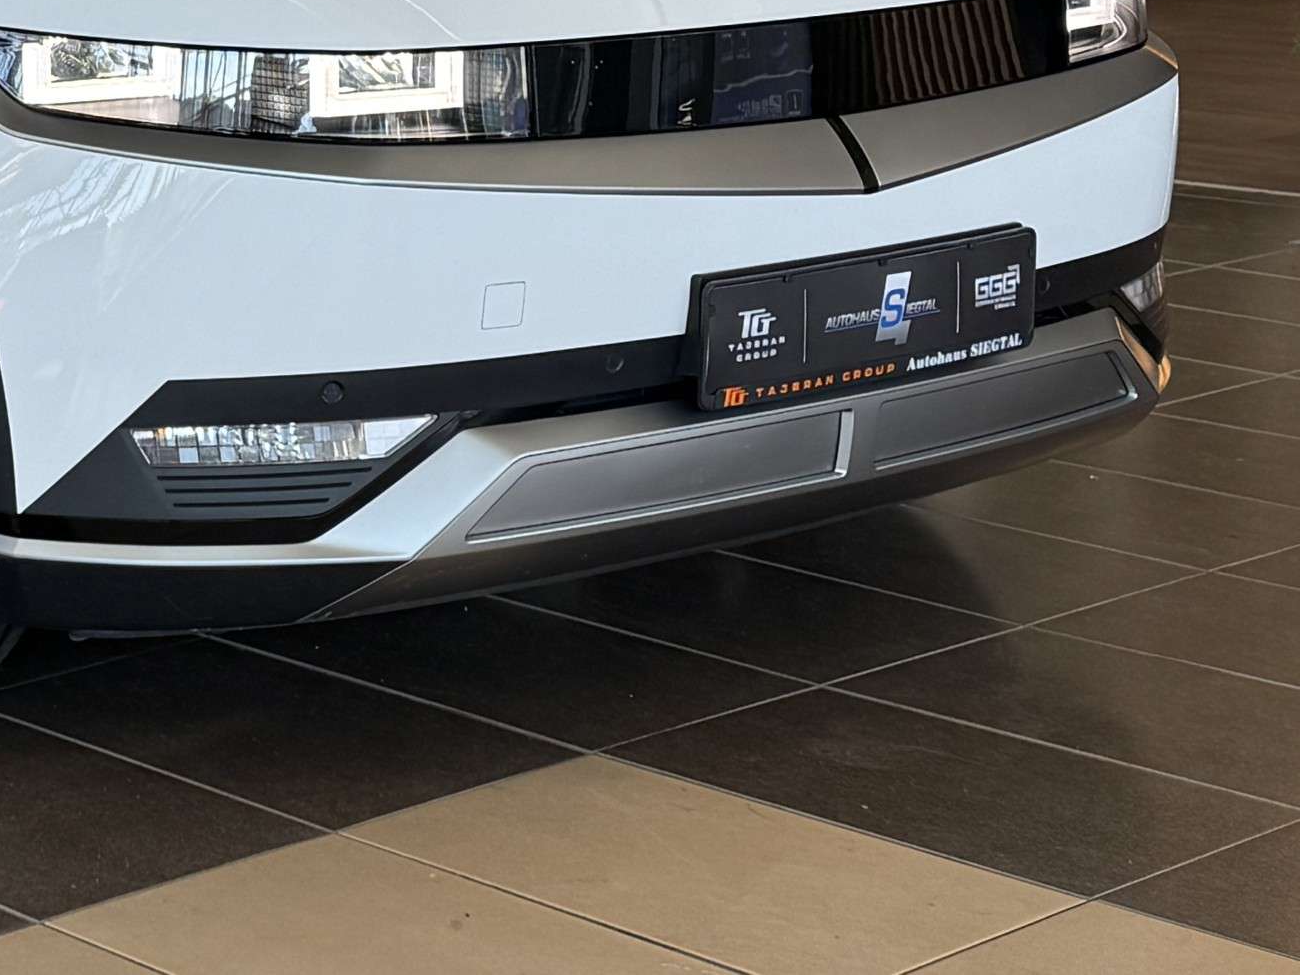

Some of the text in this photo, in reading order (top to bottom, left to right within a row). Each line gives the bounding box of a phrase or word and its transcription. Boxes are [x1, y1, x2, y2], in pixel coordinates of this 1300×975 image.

[825, 308, 881, 330] AUTOHAUS
[736, 348, 777, 363] GROUP
[842, 362, 896, 382] GROUP
[906, 351, 968, 372] Autohaus
[970, 332, 1023, 358] SIEGTAL
